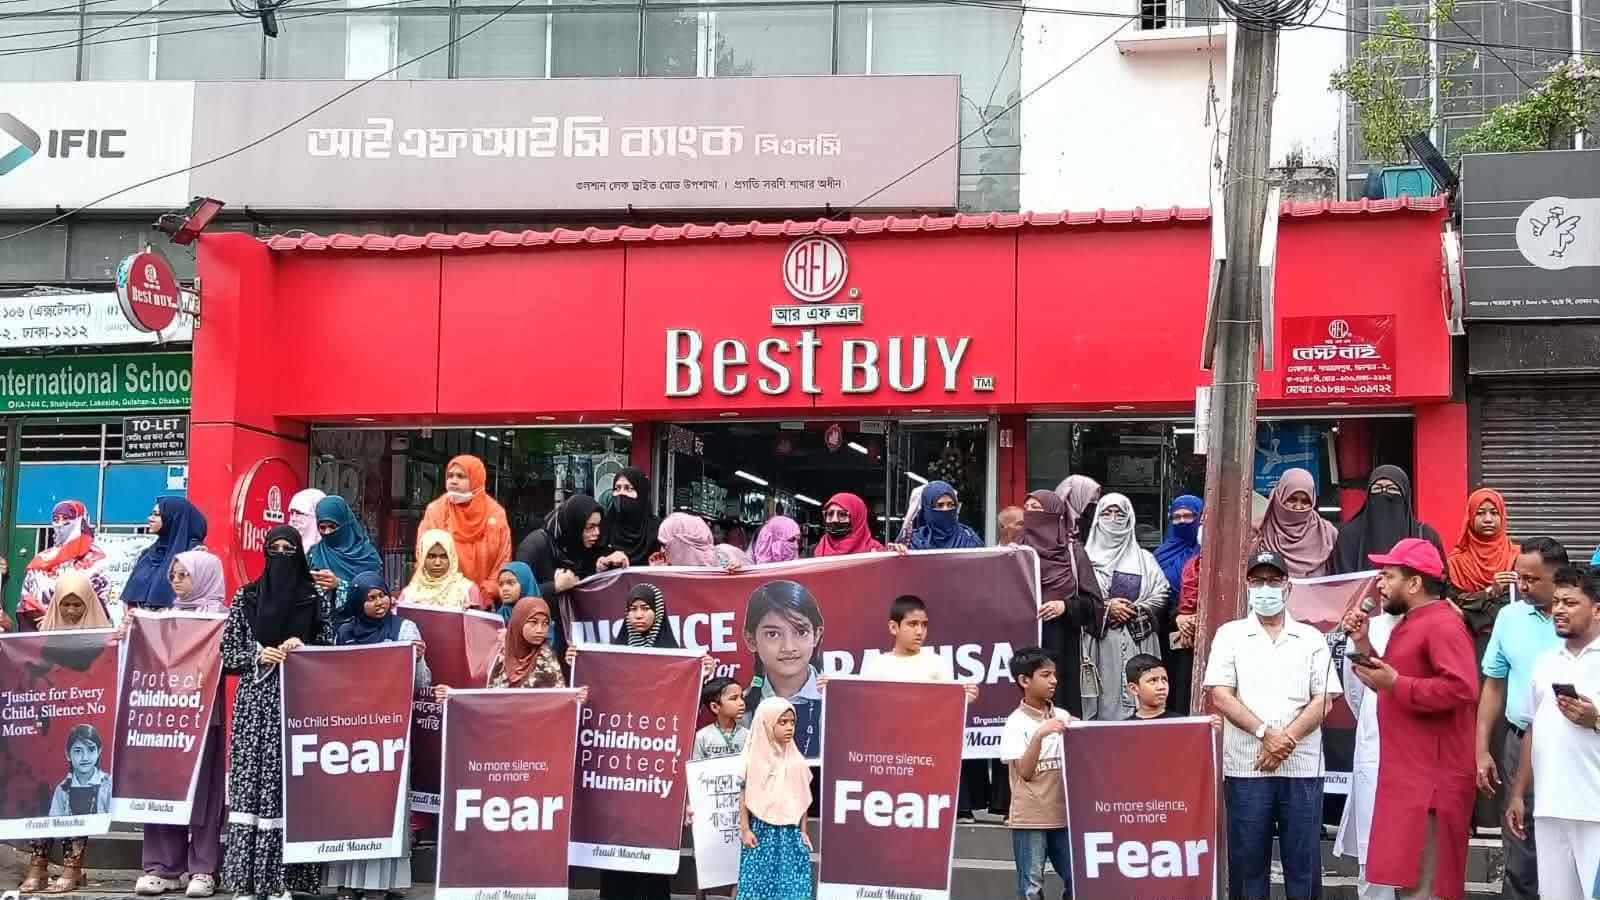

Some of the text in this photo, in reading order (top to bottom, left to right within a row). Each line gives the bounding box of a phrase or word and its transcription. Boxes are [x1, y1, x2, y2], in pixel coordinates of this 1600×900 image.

[48, 129, 127, 158] IFIC
[307, 116, 841, 160] আই এফ আই সি ব্যাংক পিএলসি
[790, 239, 841, 294] RFL
[775, 304, 860, 322] আর এফ এল
[664, 327, 823, 398] Best
[840, 335, 973, 394] BUY
[132, 419, 180, 431] TO-LET
[243, 520, 272, 553] Bes
[131, 671, 204, 689] Protect
[704, 657, 741, 684] for
[49, 688, 67, 701] for
[70, 686, 104, 703] Every
[129, 691, 205, 712] Childhood,
[2, 703, 106, 722] Child, Silence No
[128, 709, 202, 729] Protect
[288, 711, 402, 728] No Child Should Live in
[582, 708, 680, 732] Protect
[127, 730, 196, 753] Humanity
[580, 729, 682, 756] Childhood,
[291, 734, 405, 777] Fear
[468, 760, 549, 773] No more silence,
[581, 749, 680, 775] Protect
[849, 751, 935, 767] No more silence,
[488, 773, 529, 782] no more
[870, 765, 914, 776] no more
[582, 770, 673, 798] Humanity
[454, 788, 564, 832] Fear
[833, 779, 951, 829] Fear
[1095, 799, 1188, 813] No more silence,
[1119, 813, 1167, 824] no more
[1083, 831, 1208, 879] Fear
